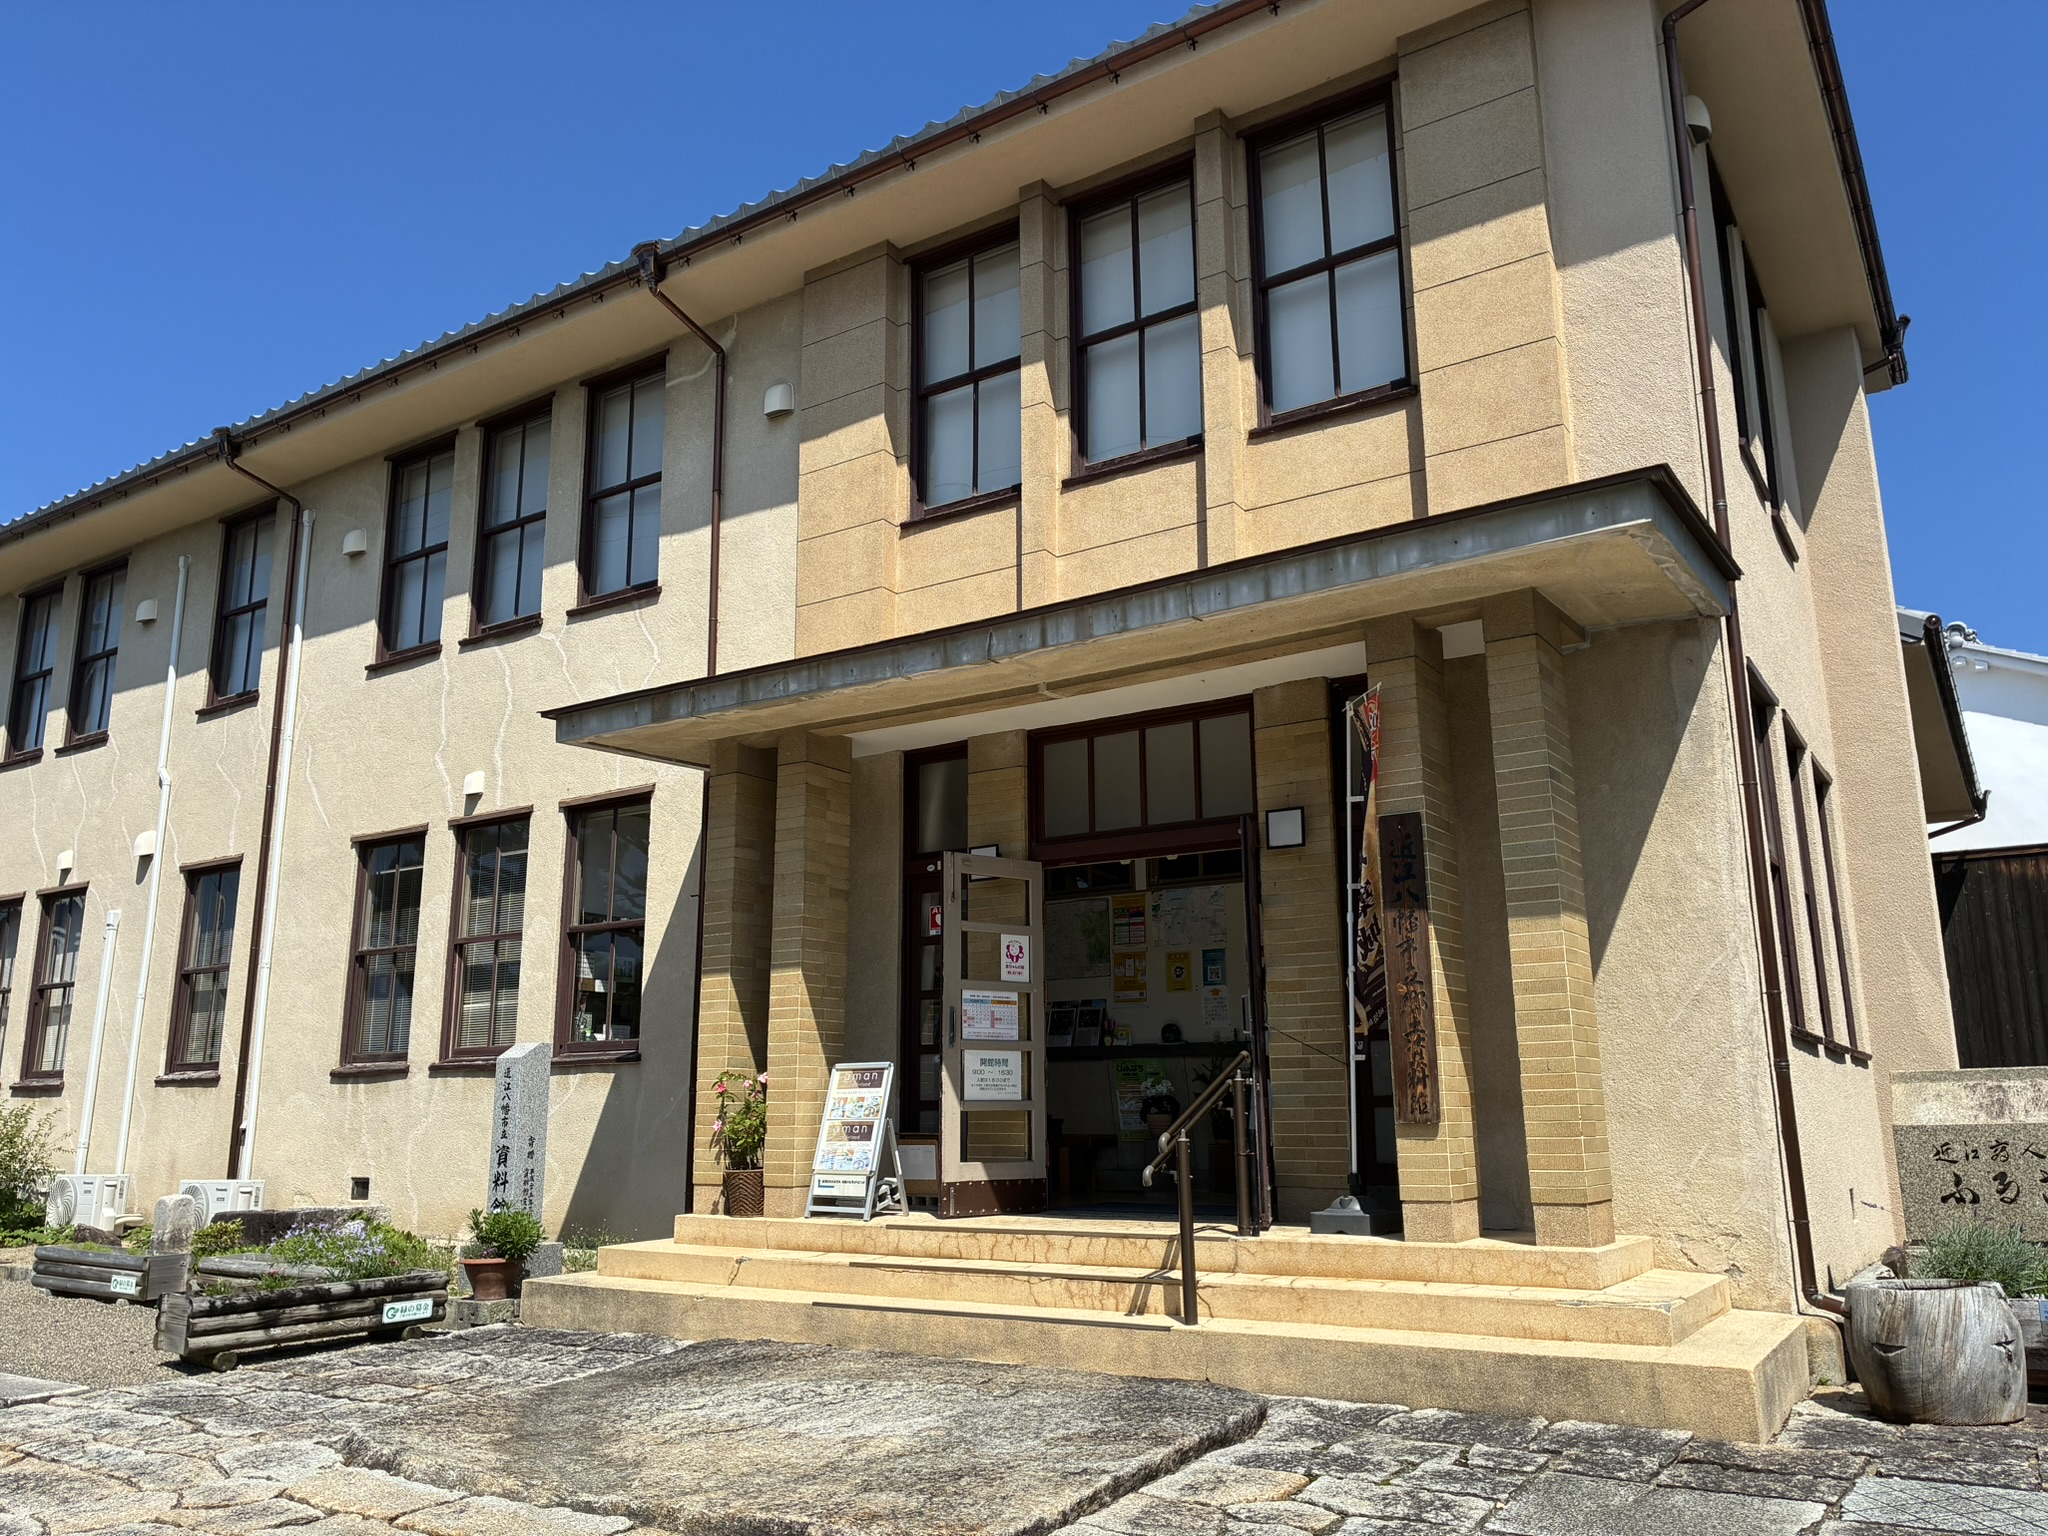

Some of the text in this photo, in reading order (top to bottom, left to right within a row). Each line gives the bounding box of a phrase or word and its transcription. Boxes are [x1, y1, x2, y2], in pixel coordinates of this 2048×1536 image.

[979, 1057, 1009, 1067] 開館時間
[843, 1071, 878, 1081] aman
[832, 1124, 868, 1134] aman
